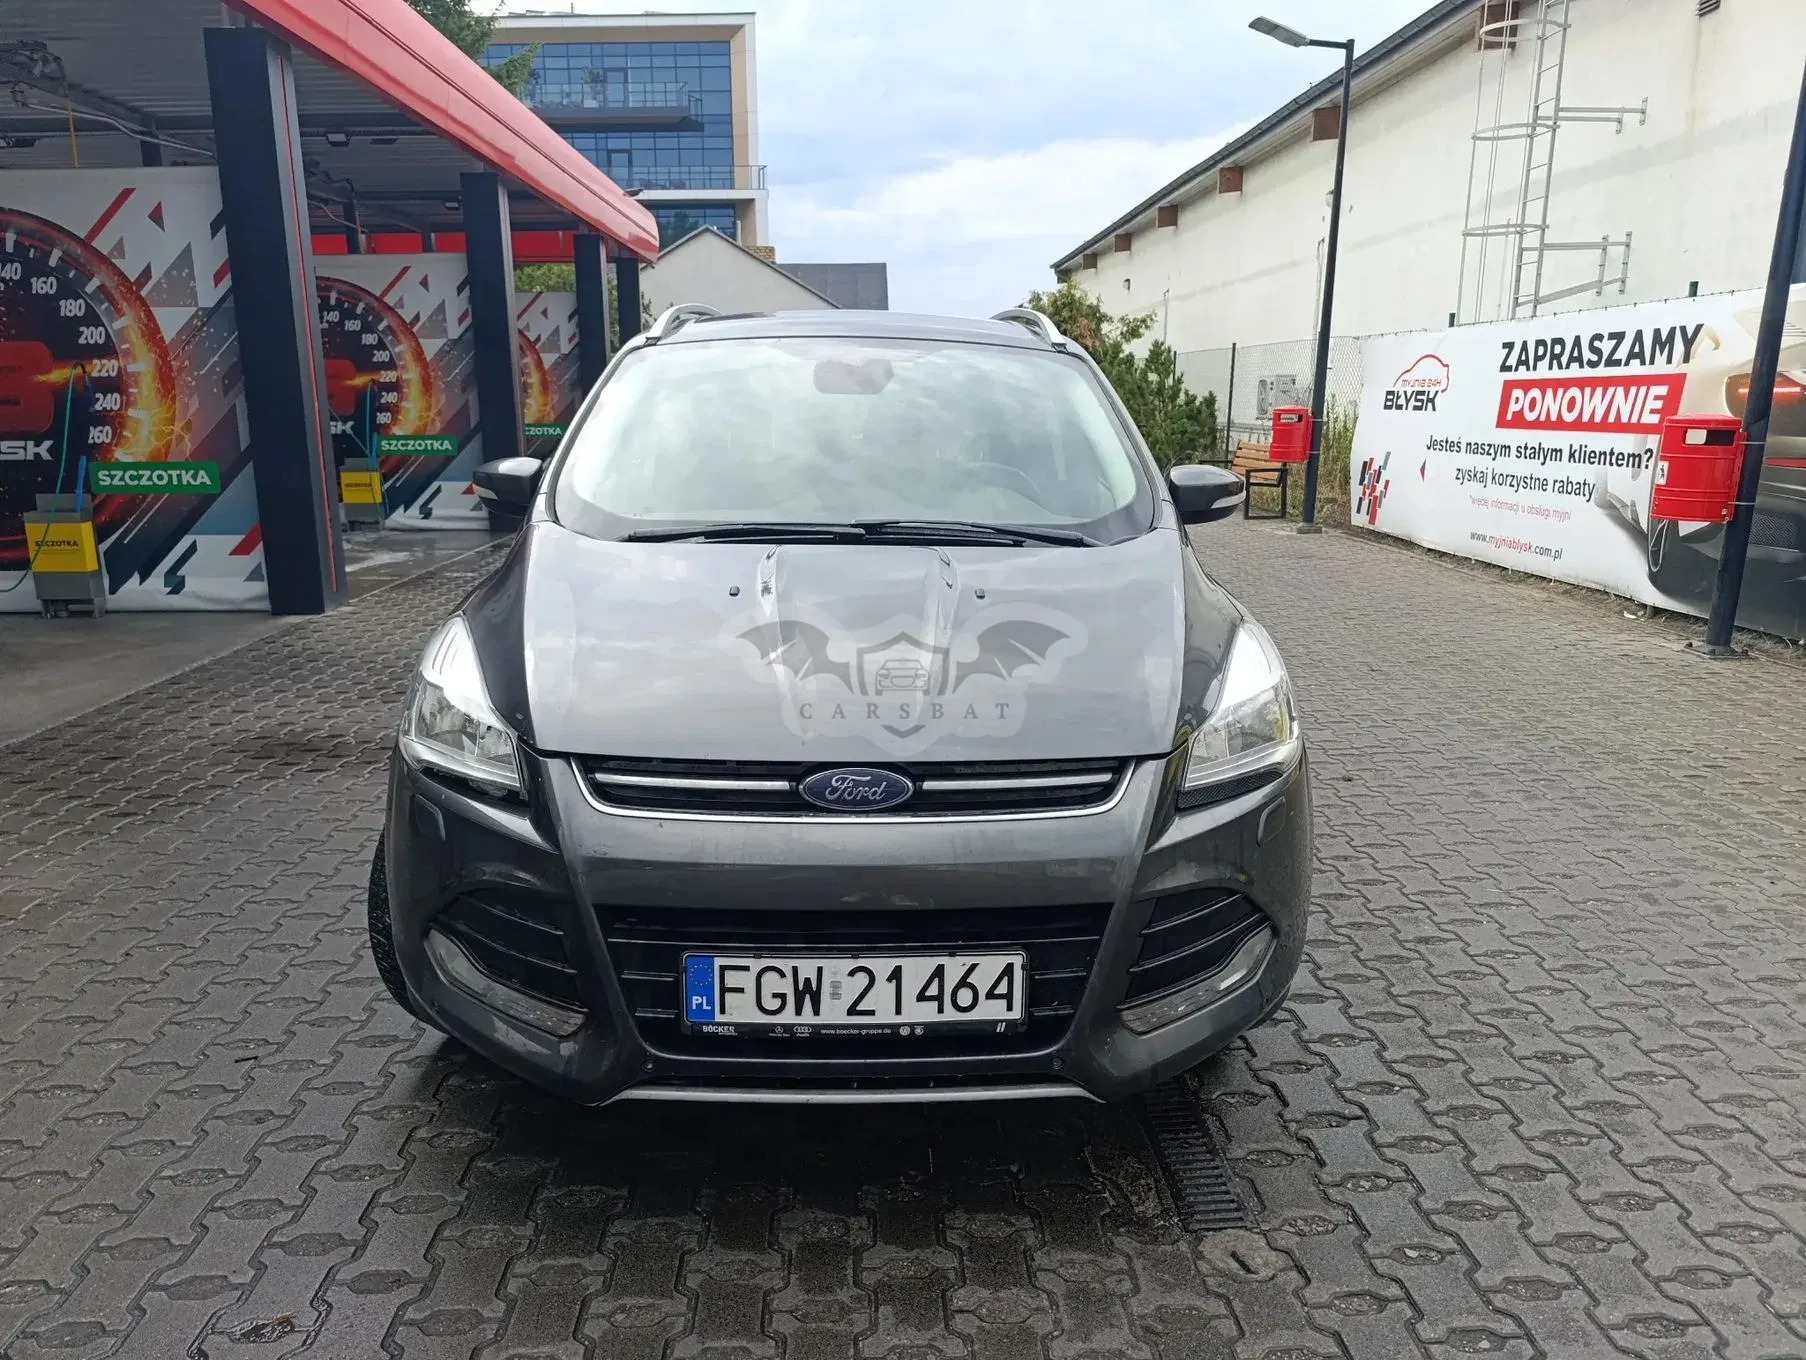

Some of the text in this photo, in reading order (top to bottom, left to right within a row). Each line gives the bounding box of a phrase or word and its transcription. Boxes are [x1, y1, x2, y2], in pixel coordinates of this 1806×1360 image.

[30, 277, 57, 294] 160
[59, 299, 85, 317] 180
[322, 311, 340, 322] 140
[344, 320, 361, 331] 160
[78, 327, 106, 344] 200
[361, 334, 379, 345] 180
[372, 351, 390, 362] 200
[1499, 323, 1704, 373] ZAPRASZAMY
[91, 359, 118, 377] 220
[380, 371, 397, 382] 220
[94, 393, 120, 411] 240
[380, 392, 398, 403] 240
[1383, 390, 1440, 412] BŁYSK
[1505, 385, 1670, 425] PONOWNIE
[381, 440, 452, 450] SZCZOTKA
[1426, 434, 1655, 470] Jesteś naszym stałym klientem?
[98, 470, 211, 486] SZCZOTKA
[1455, 466, 1596, 503] zyskaj korzystne rabaty
[825, 774, 887, 801] Ford
[718, 961, 1015, 1017] FGW 21464
[692, 996, 711, 1010] PL
